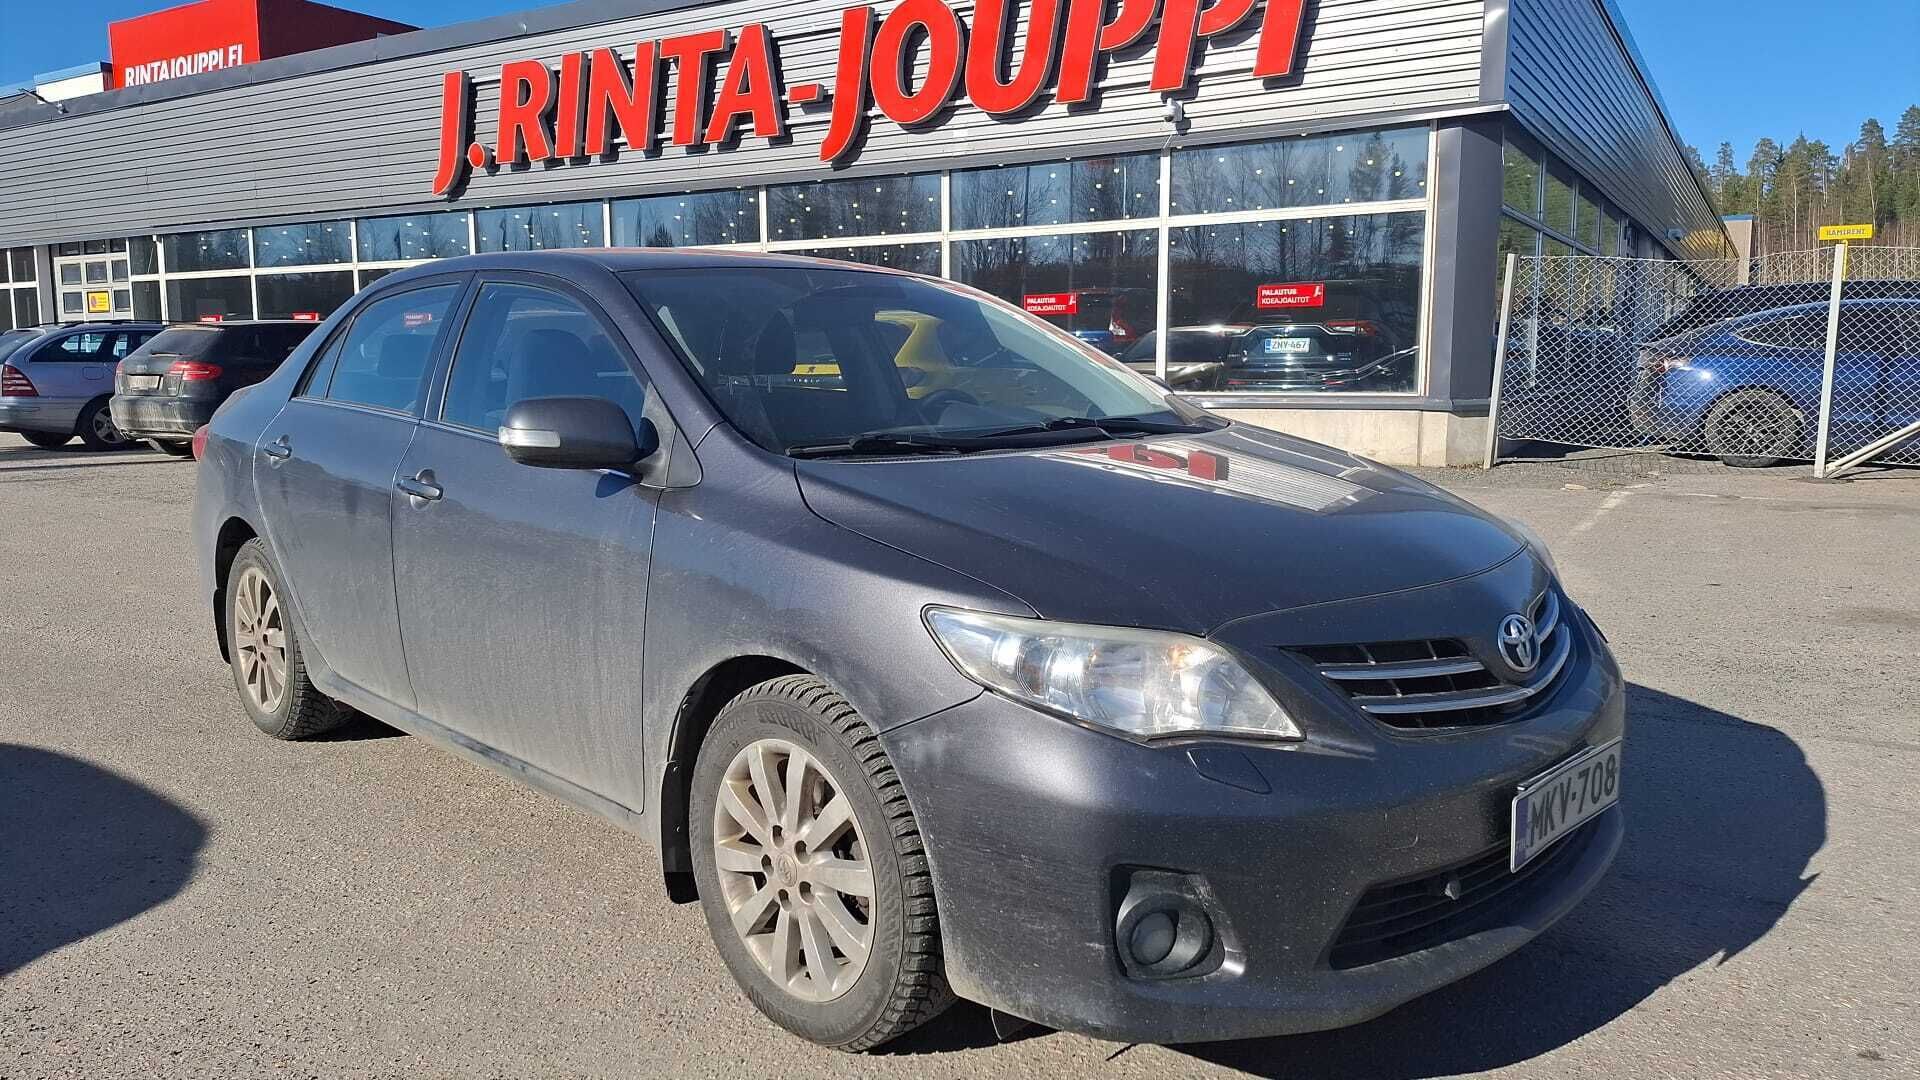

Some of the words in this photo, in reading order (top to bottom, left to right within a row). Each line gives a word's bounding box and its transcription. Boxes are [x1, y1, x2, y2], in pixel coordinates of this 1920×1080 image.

[1261, 288, 1297, 296] PALAUTUS
[1261, 296, 1310, 305] KOEAJOAUTOT
[1271, 340, 1307, 350] ZNY-467
[1530, 753, 1617, 848] MKV-708
